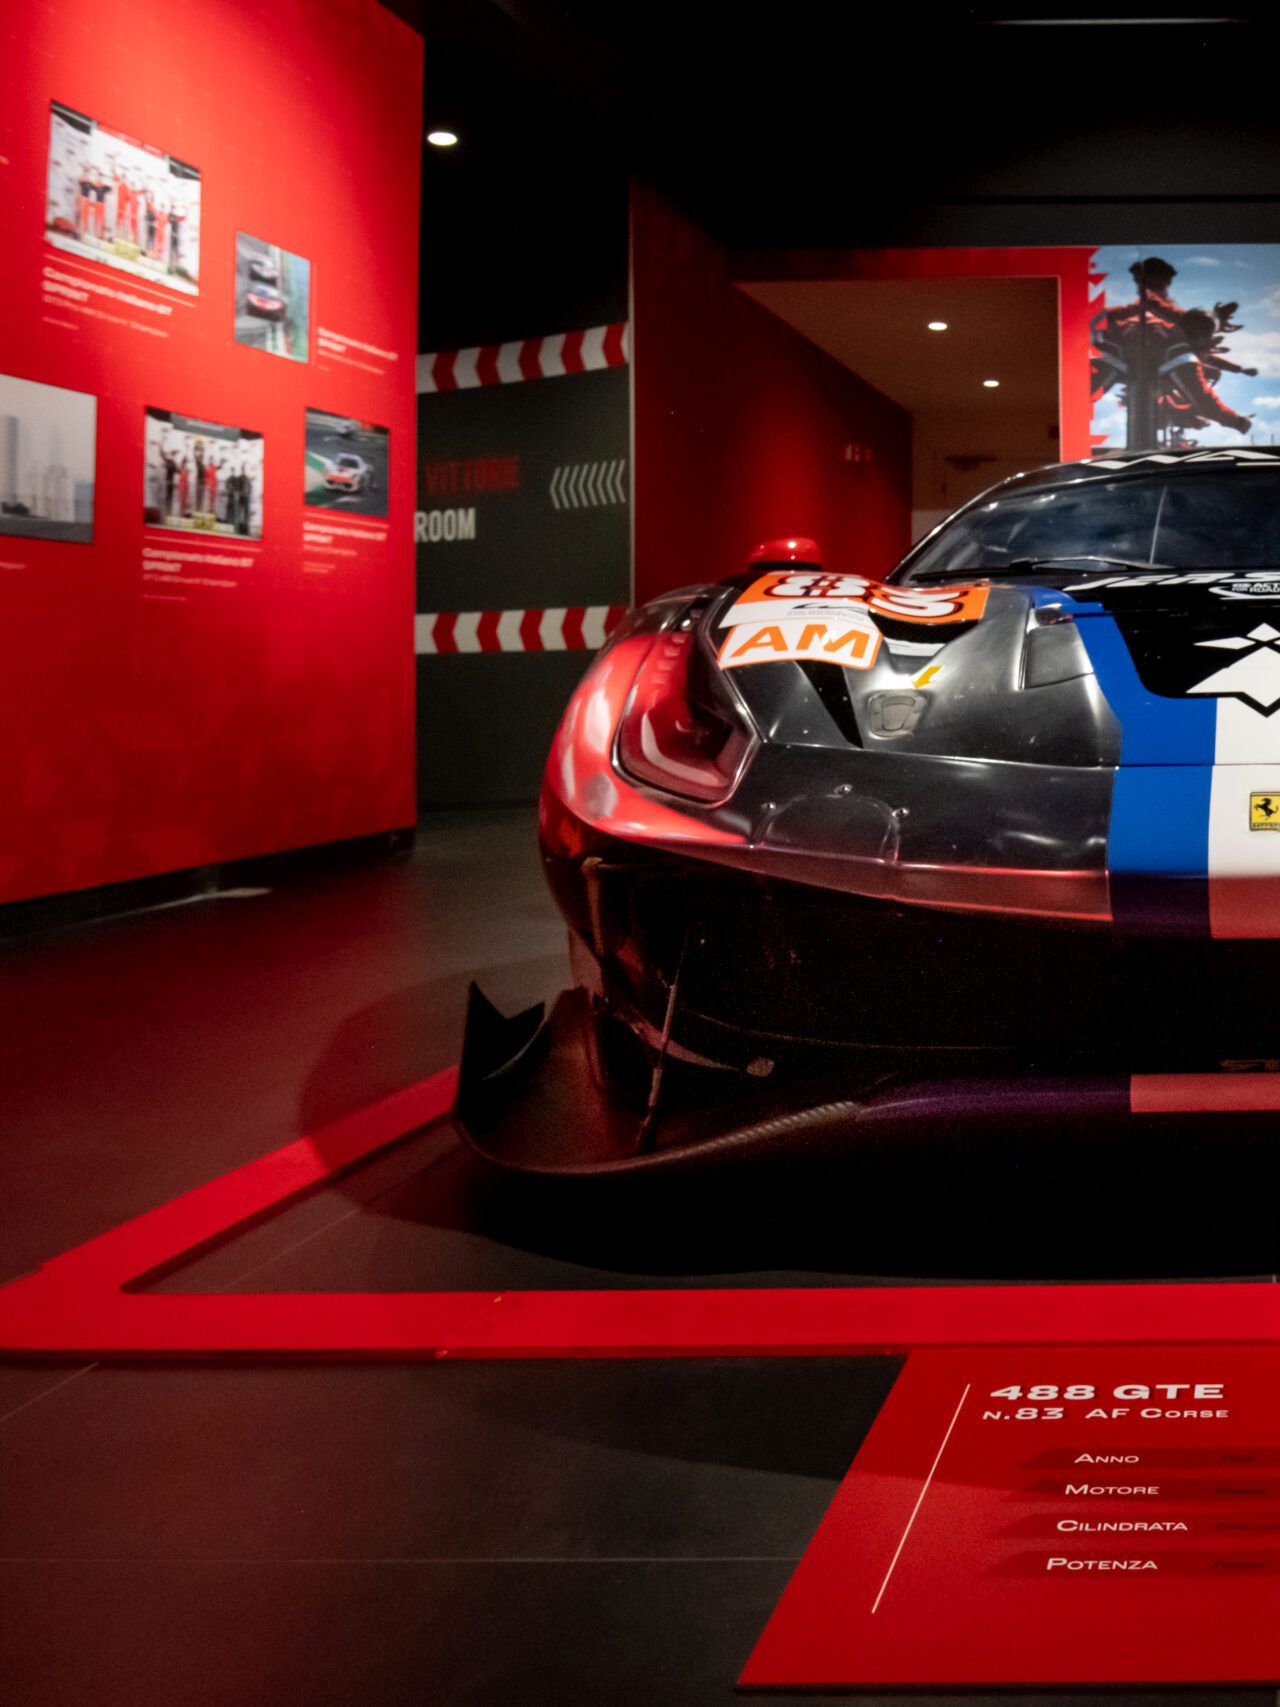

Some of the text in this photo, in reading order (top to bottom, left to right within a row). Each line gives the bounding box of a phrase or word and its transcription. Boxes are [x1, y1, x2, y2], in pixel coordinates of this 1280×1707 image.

[414, 508, 476, 543] ROOM
[729, 624, 871, 659] AM
[990, 1384, 1224, 1400] 488 GTE
[983, 1407, 1229, 1420] N.83 AF CORSE
[1074, 1453, 1140, 1464] ANNO
[1064, 1484, 1160, 1495] MOTORE
[1057, 1519, 1188, 1532] CILINDRATA
[1046, 1557, 1158, 1570] POTENZA
